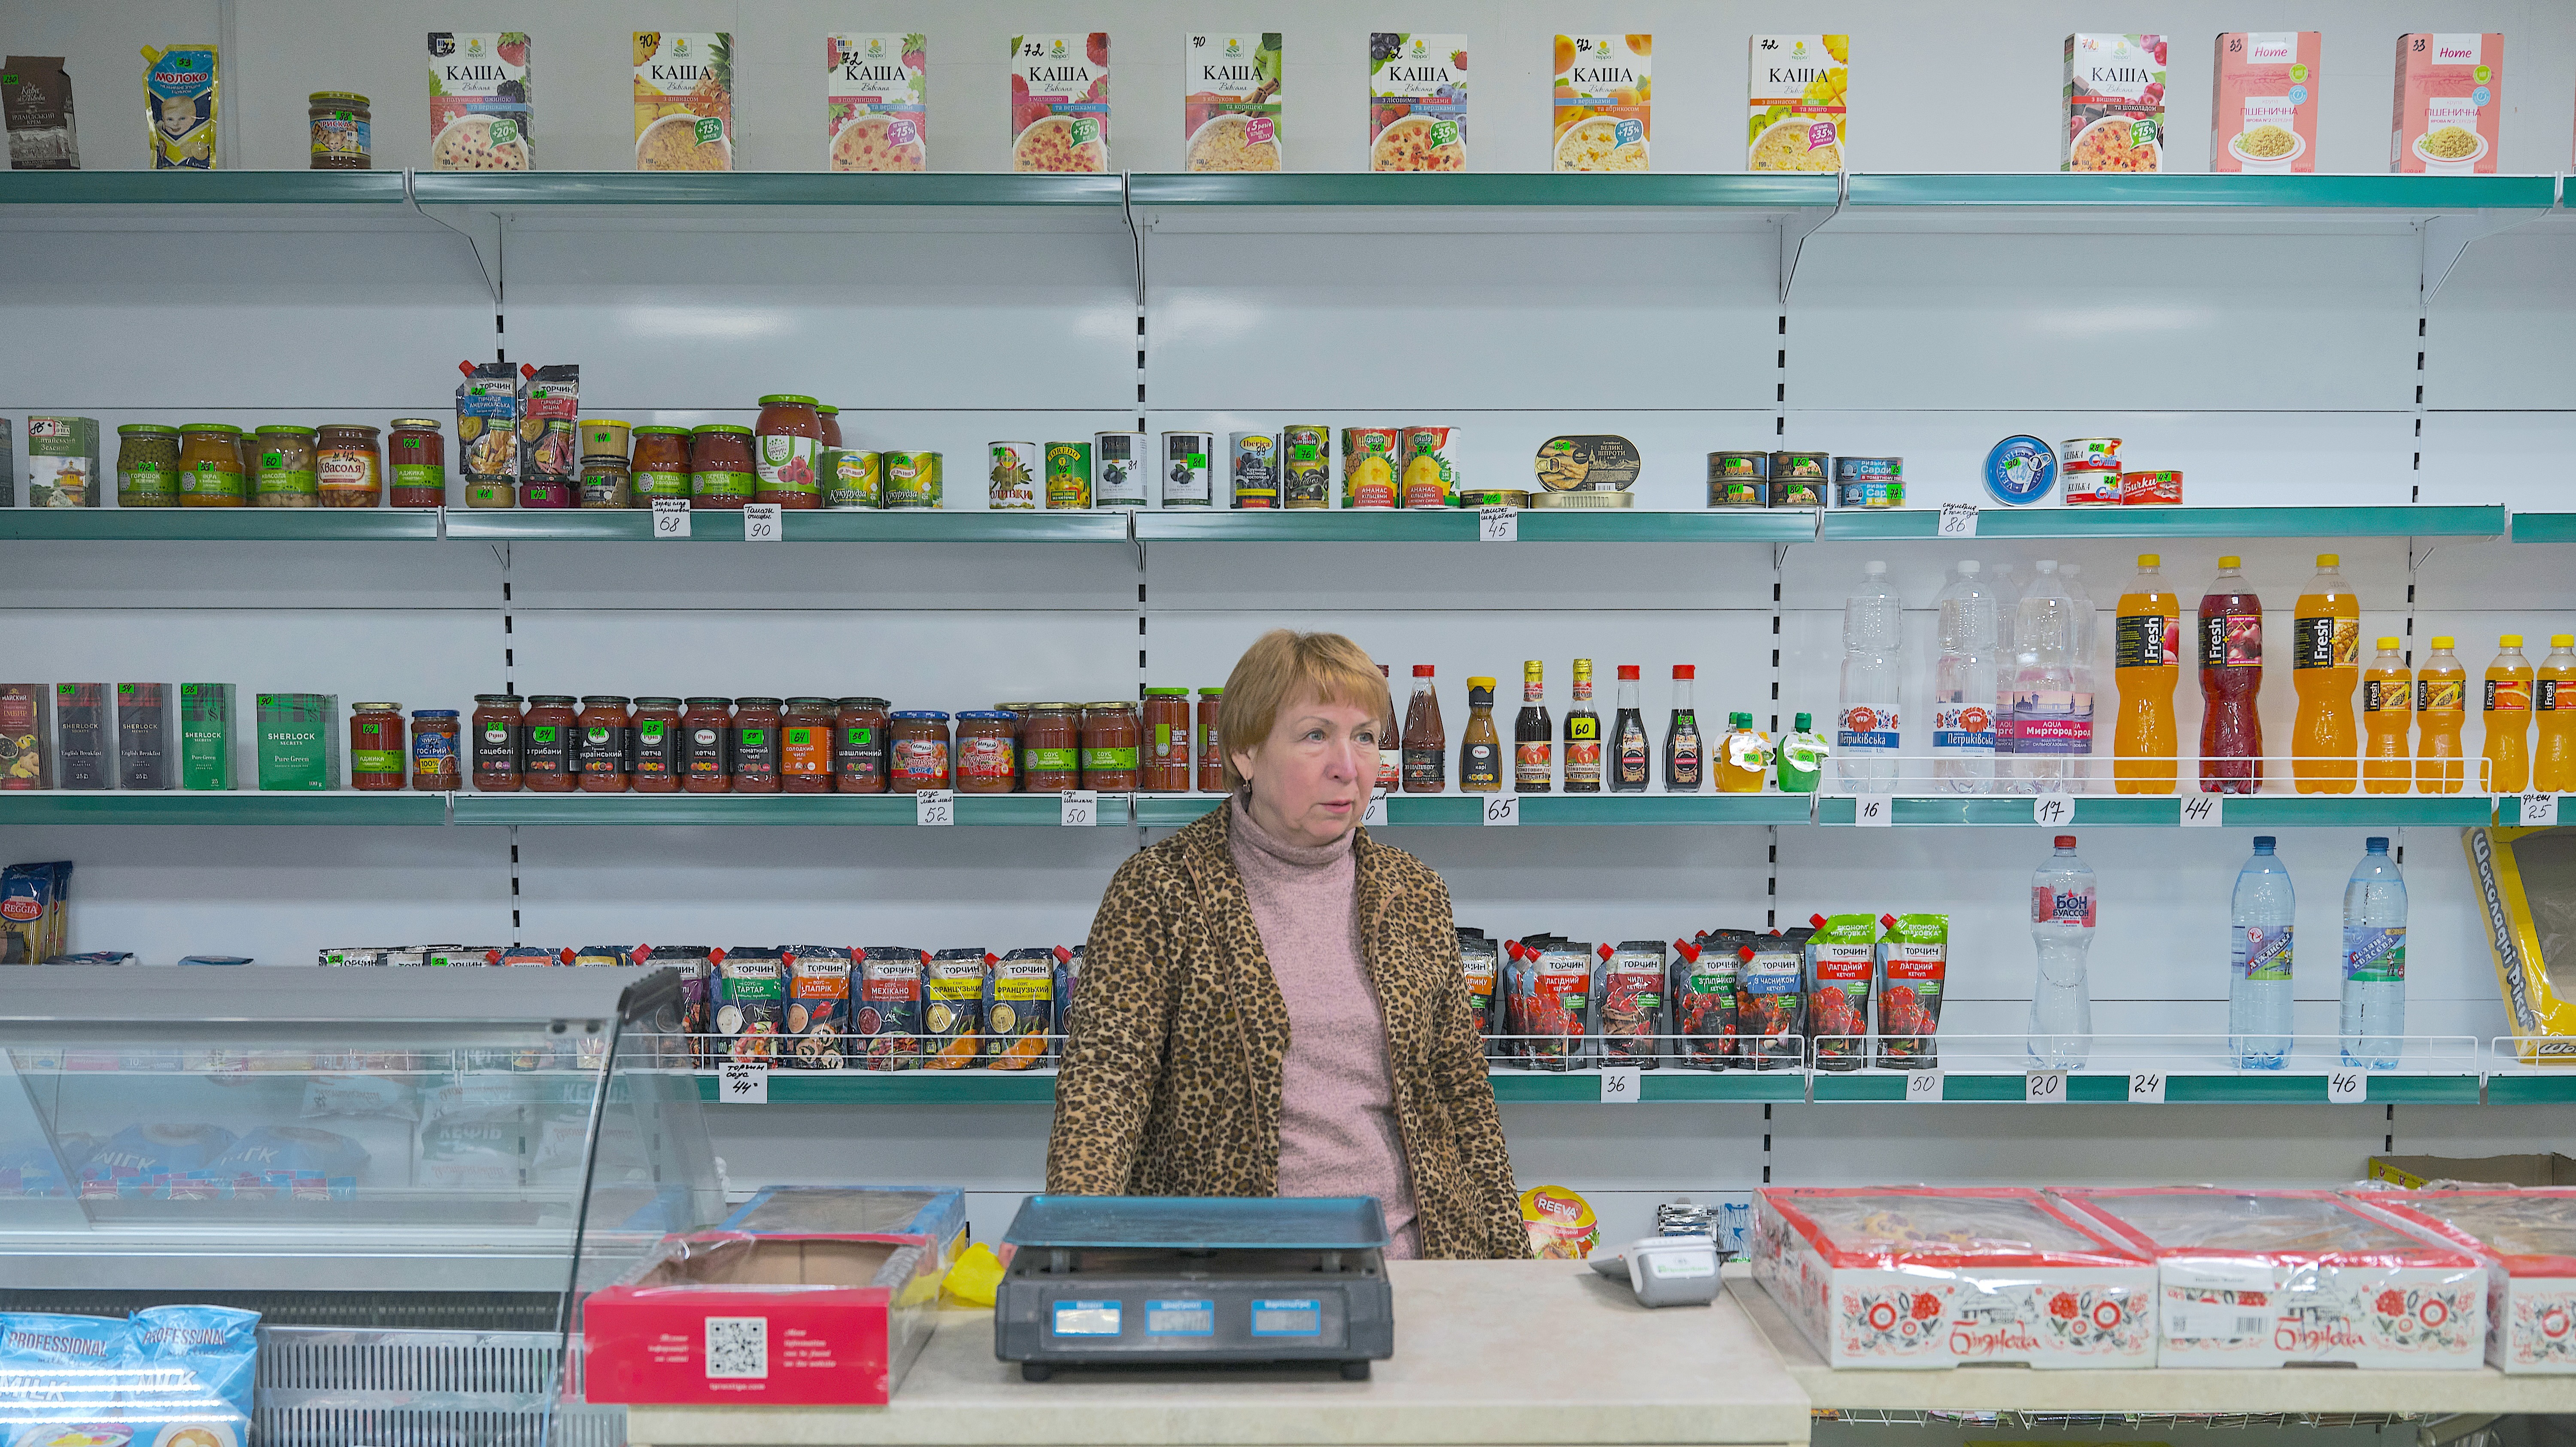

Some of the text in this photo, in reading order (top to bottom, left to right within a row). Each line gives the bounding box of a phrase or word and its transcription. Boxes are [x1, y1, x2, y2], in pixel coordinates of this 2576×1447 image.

[640, 34, 653, 47] 70
[1194, 36, 1205, 48] 70
[1577, 39, 1592, 52] 72
[1761, 40, 1779, 49] 72
[2413, 39, 2425, 51] 33
[1024, 43, 1044, 57] 72
[2255, 47, 2287, 57] Home
[2440, 48, 2471, 58] Home
[843, 52, 862, 65] 72
[155, 71, 207, 83] МОЛОКО
[447, 66, 506, 79] КАША
[651, 65, 712, 79] КАША
[846, 66, 905, 80] КАША
[1029, 67, 1088, 81] КАША
[1203, 66, 1263, 80] КАША
[1389, 67, 1449, 81] КАША
[1574, 68, 1633, 82] КАША
[1769, 68, 1828, 82] КАША
[2092, 68, 2148, 82] КАША
[462, 82, 490, 91] Вівсяна
[667, 82, 695, 91] Вівсяна
[861, 82, 890, 91] Вівсяна
[1219, 82, 1247, 91] Вівсяна
[2425, 109, 2481, 117] ПШЕНИЧНА
[698, 124, 719, 133] +15%
[890, 126, 914, 137] +15%
[1433, 127, 1456, 137] +35%
[1048, 447, 1081, 460] TOREDO
[1257, 447, 1265, 455] 89
[2065, 451, 2083, 460] КІЛЬКА
[266, 457, 276, 466] 60
[320, 462, 361, 473] Квасоля
[1128, 461, 1137, 469] 81
[2008, 458, 2018, 469] 90
[2124, 478, 2155, 491] Бички
[830, 488, 866, 504] Кукурудза
[991, 490, 1030, 499] ОЛИВКИ
[660, 517, 679, 531] 68
[751, 524, 770, 537] 90
[1488, 522, 1508, 537] 45
[1946, 517, 1966, 532] 86
[2145, 618, 2159, 664] iFresh
[2209, 618, 2221, 664] iFresh
[2314, 619, 2328, 665] iFresh
[365, 725, 376, 733] 69
[1576, 724, 1589, 734] 60
[2027, 727, 2072, 736] Миргород
[794, 733, 804, 742] 64
[1840, 733, 1886, 746] Петриківська
[532, 748, 561, 756] грибами
[580, 750, 622, 758] український
[925, 807, 947, 822] 52
[1067, 808, 1085, 822] 50
[1489, 797, 1515, 820] 65
[1864, 804, 1879, 816] 16
[2040, 801, 2065, 822] 17
[2185, 798, 2212, 820] 44
[2529, 804, 2551, 818] 25
[4, 905, 37, 913] REGGIA
[2057, 896, 2087, 909] БОН
[2352, 934, 2387, 962] ПОЛЯНА
[2353, 937, 2394, 969] КВАСОВА
[1608, 1076, 1625, 1092] 36
[1913, 1077, 1935, 1091] 50
[2032, 1076, 2057, 1095] 20
[2135, 1074, 2159, 1093] 24
[2333, 1074, 2356, 1093] 46
[1538, 1198, 1578, 1219] REEVA
[9, 1332, 107, 1358] PROFESSIONAL
